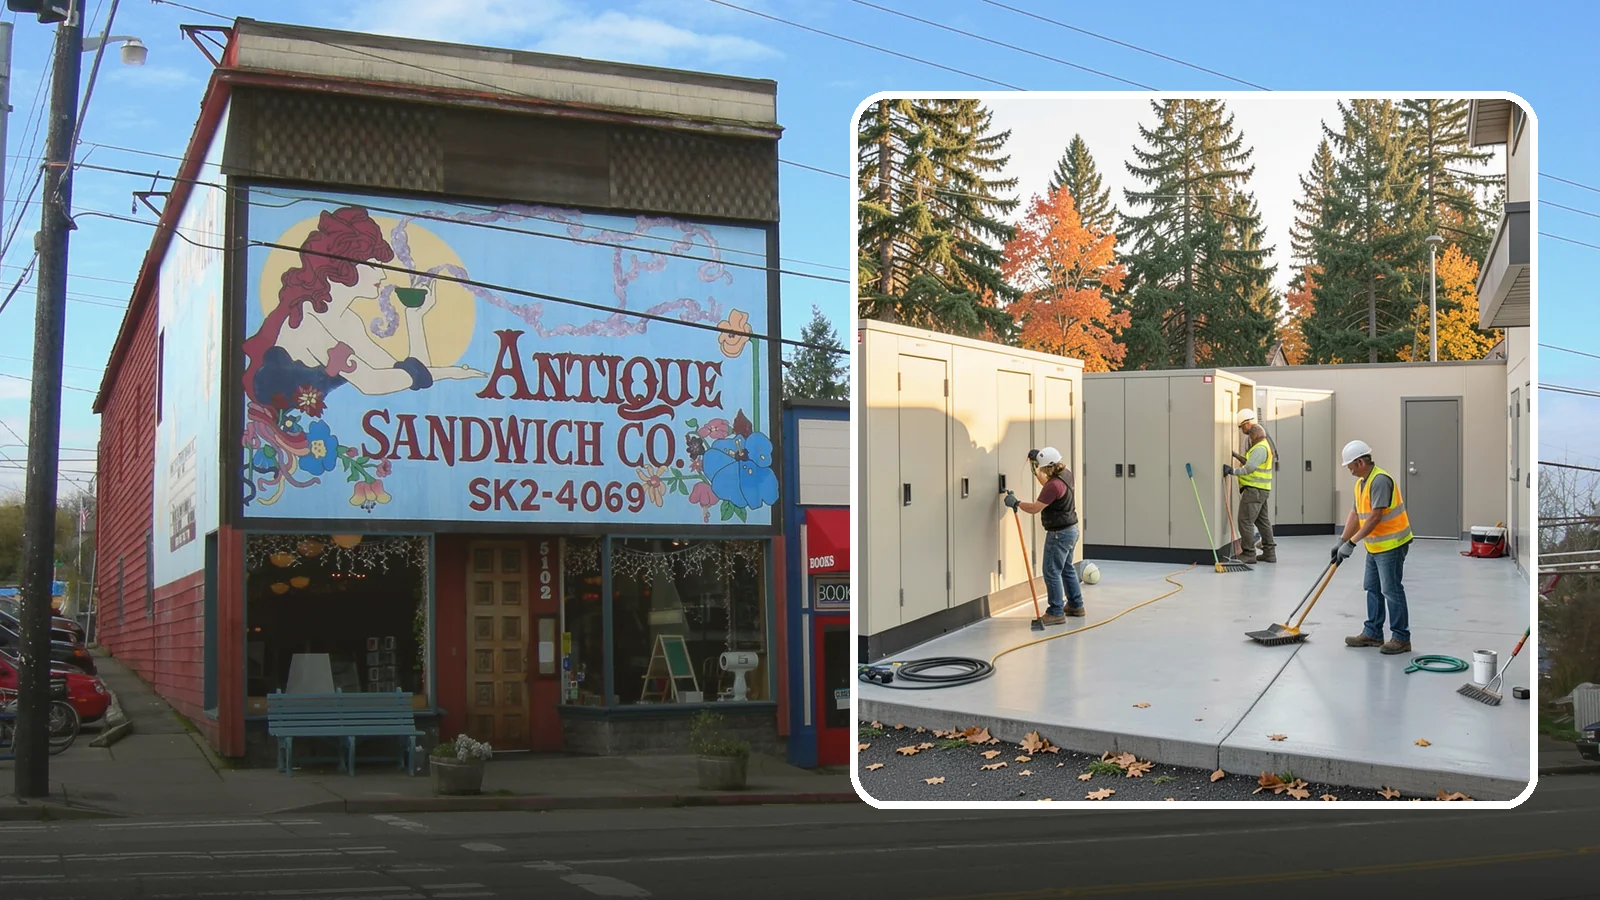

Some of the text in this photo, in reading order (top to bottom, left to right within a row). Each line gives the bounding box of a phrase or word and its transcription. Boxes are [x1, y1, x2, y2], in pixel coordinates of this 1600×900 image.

[476, 329, 723, 420] ANTIQUE
[361, 408, 685, 469] SANDWICH CO.
[468, 477, 645, 513] SK2-4069
[540, 541, 551, 600] 5102
[809, 555, 835, 569] BOOKS
